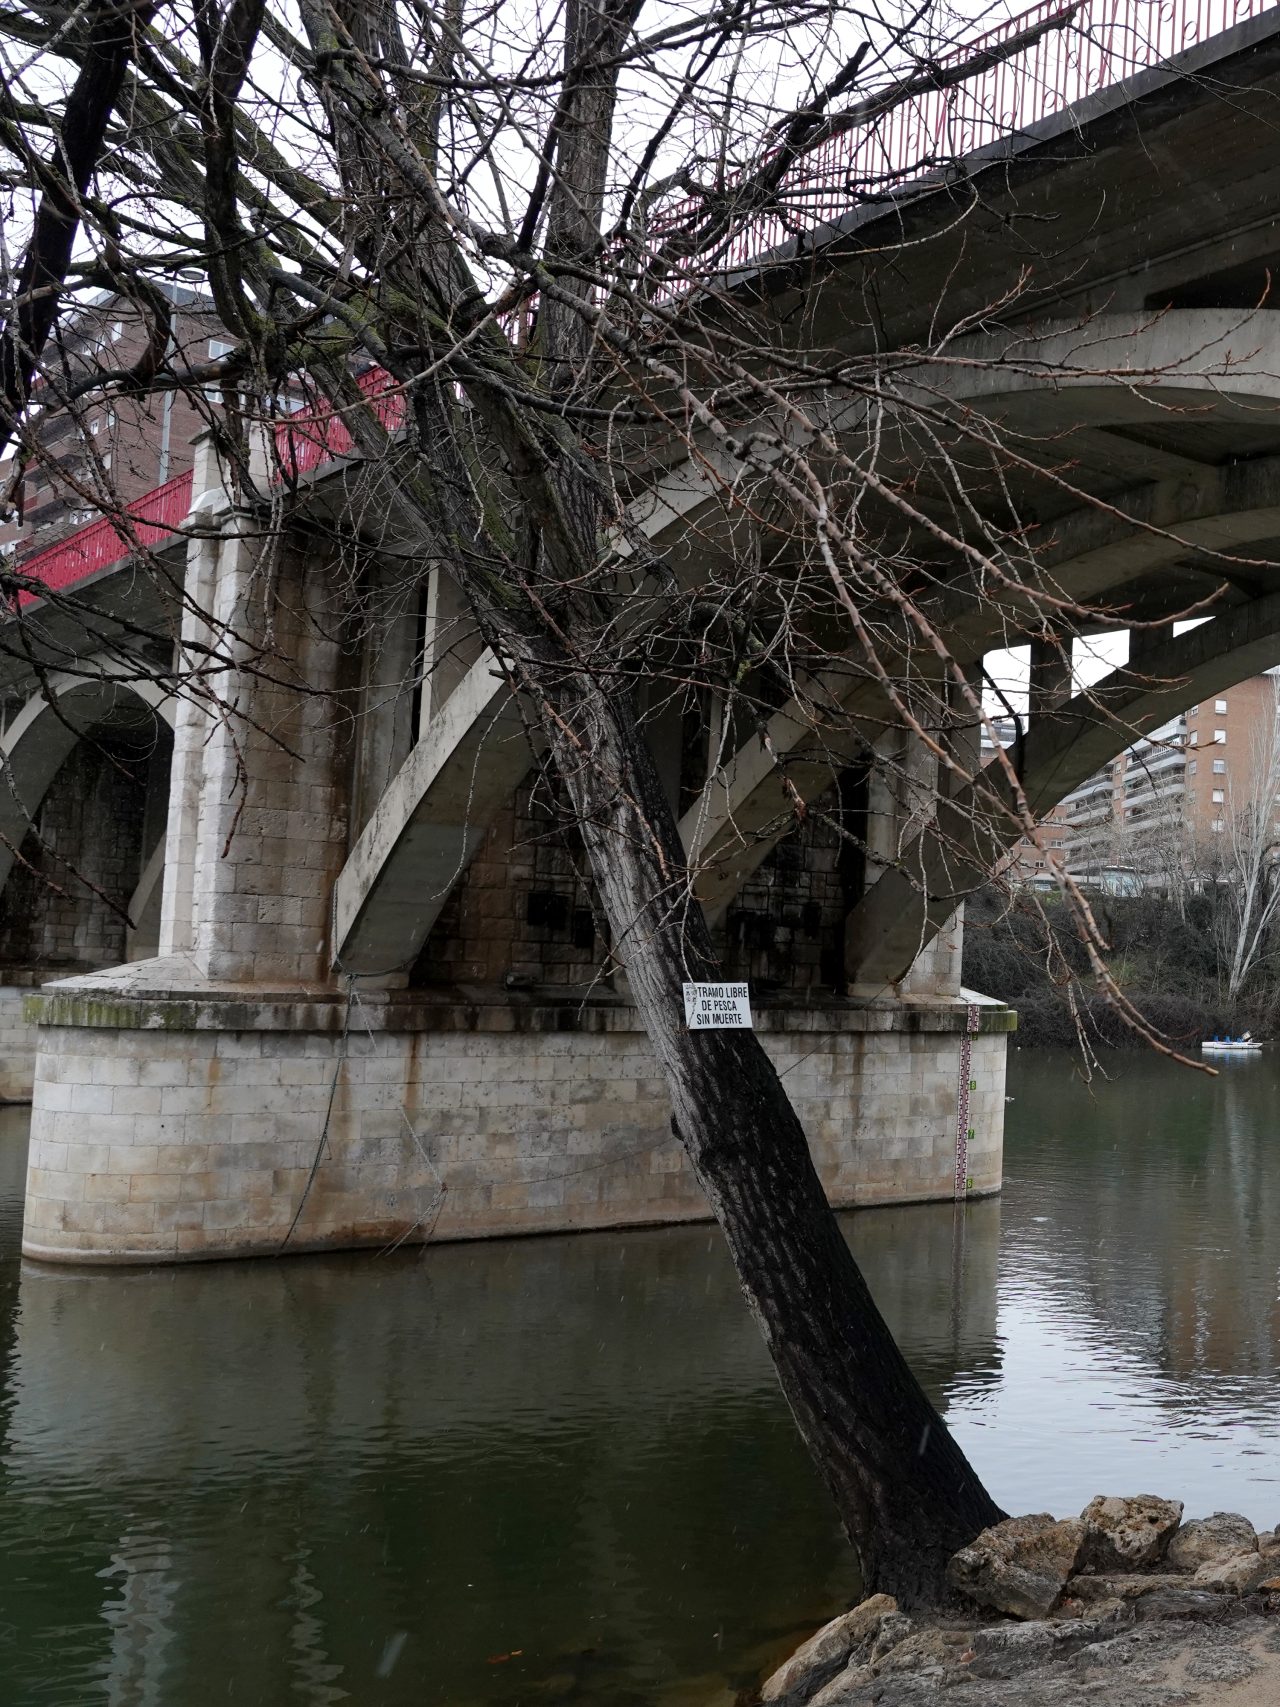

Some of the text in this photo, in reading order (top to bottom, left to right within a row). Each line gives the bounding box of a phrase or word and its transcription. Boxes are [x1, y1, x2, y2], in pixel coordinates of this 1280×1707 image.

[697, 986, 723, 998] TRAMO
[726, 986, 748, 998] LIBRE
[702, 1000, 737, 1011] DE PESCA
[696, 1013, 743, 1025] SIN MUERTE
